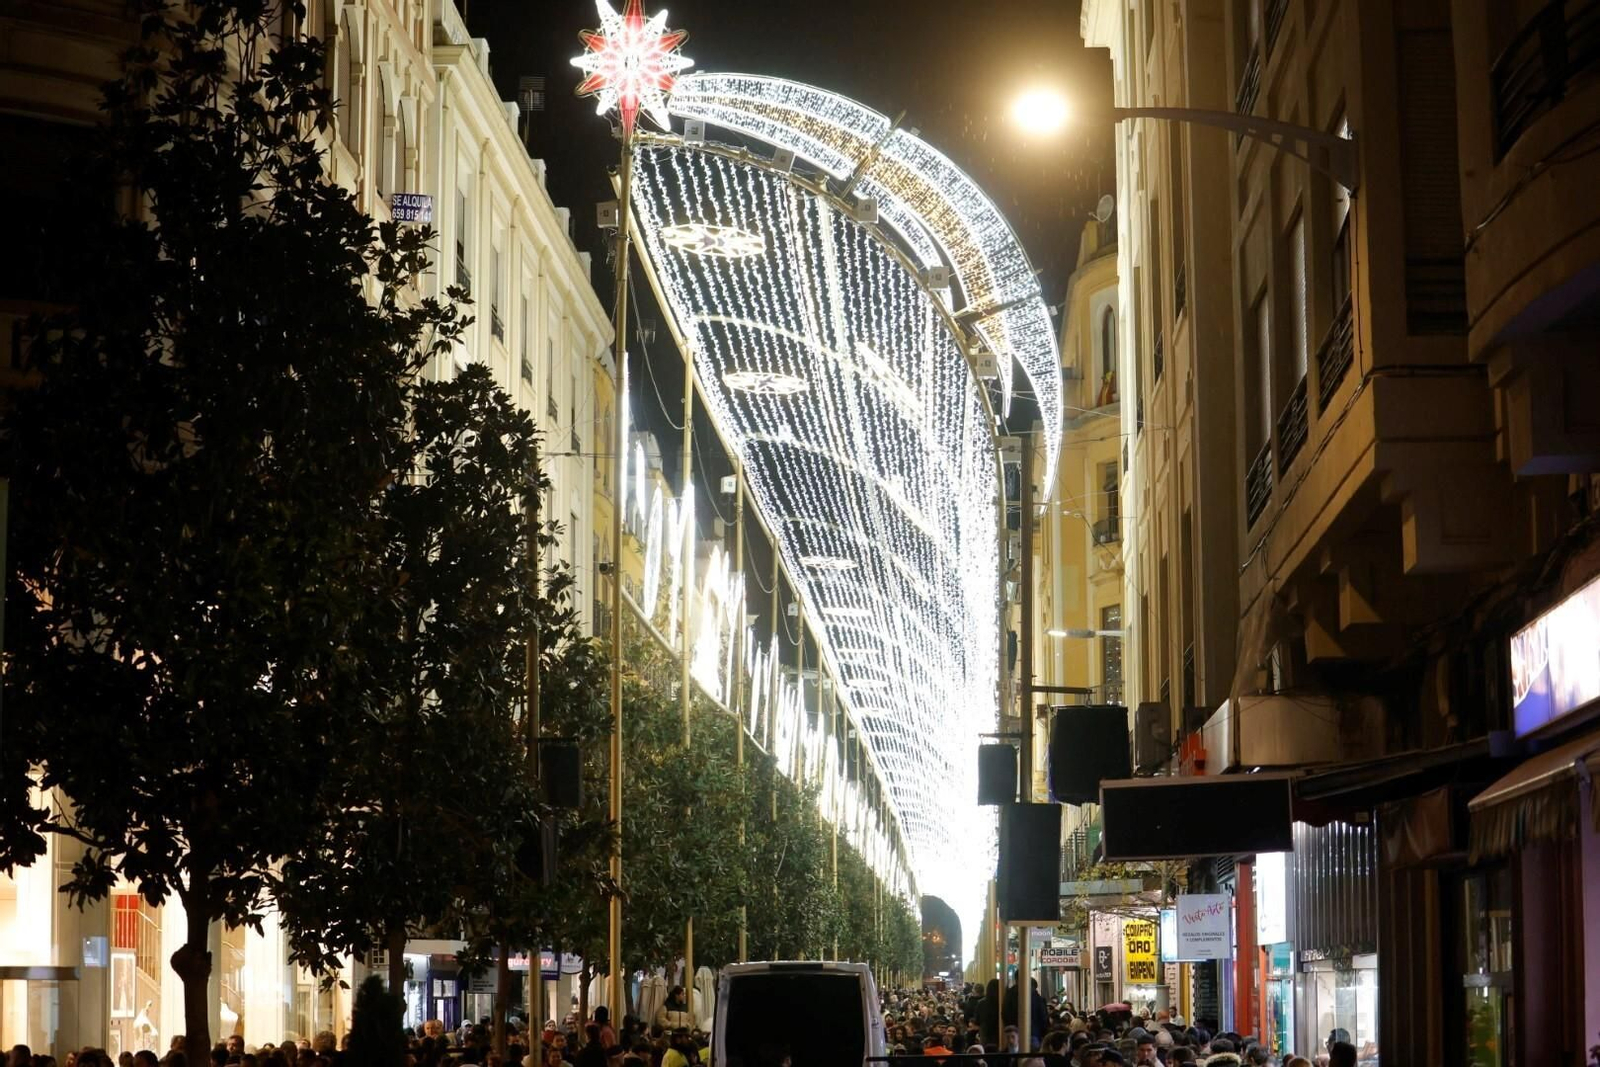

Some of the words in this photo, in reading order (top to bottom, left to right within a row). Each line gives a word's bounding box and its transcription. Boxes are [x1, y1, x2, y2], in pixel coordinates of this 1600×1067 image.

[393, 195, 402, 206] SE
[403, 196, 432, 208] ALQUILA
[392, 208, 404, 219] 659
[406, 209, 419, 220] 815
[1125, 923, 1153, 937] COMPRO
[1129, 940, 1151, 953] ORO
